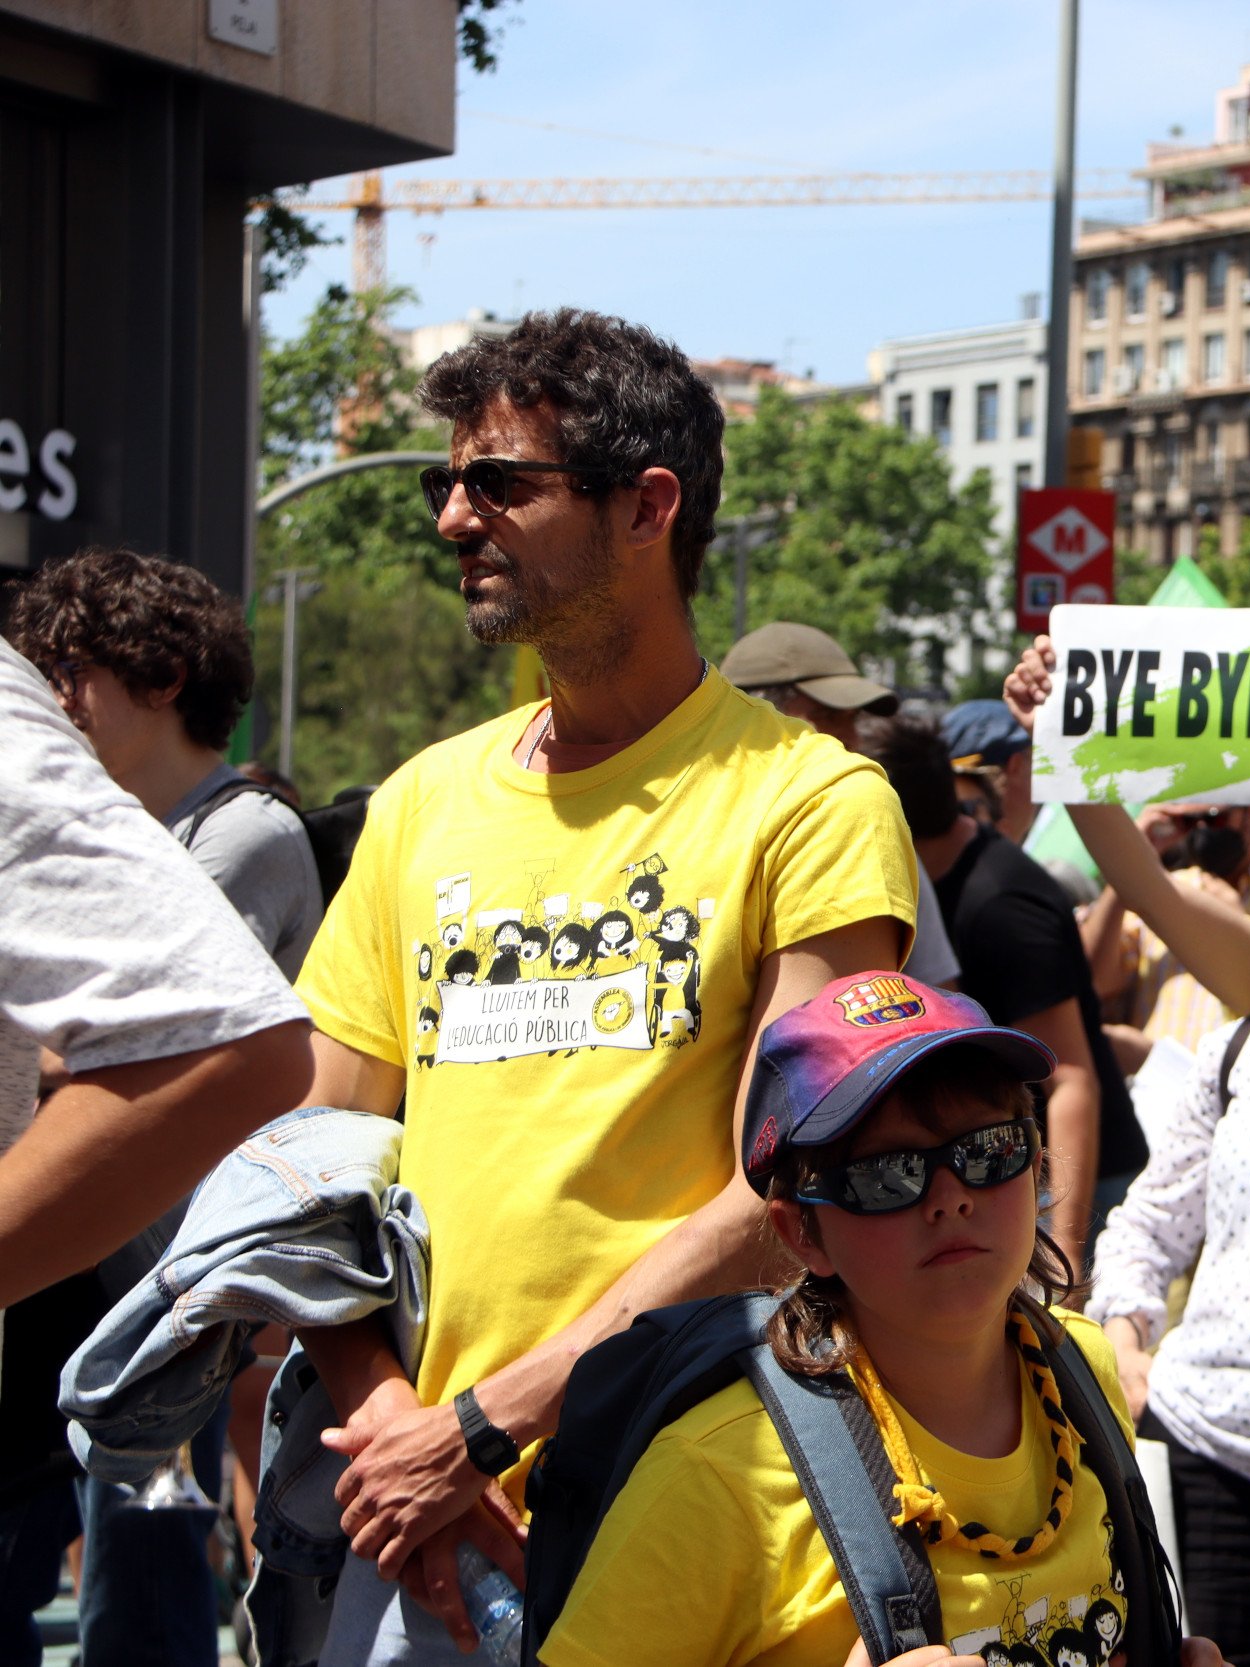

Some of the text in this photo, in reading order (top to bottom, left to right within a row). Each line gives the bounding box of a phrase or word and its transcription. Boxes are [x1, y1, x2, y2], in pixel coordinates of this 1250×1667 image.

[1053, 523, 1085, 553] M
[1062, 648, 1160, 737] BYE
[481, 986, 570, 1014] LLUITEM PER
[447, 1017, 518, 1050] L'EDUCACIÓ
[526, 1015, 588, 1044] PÚBLICA
